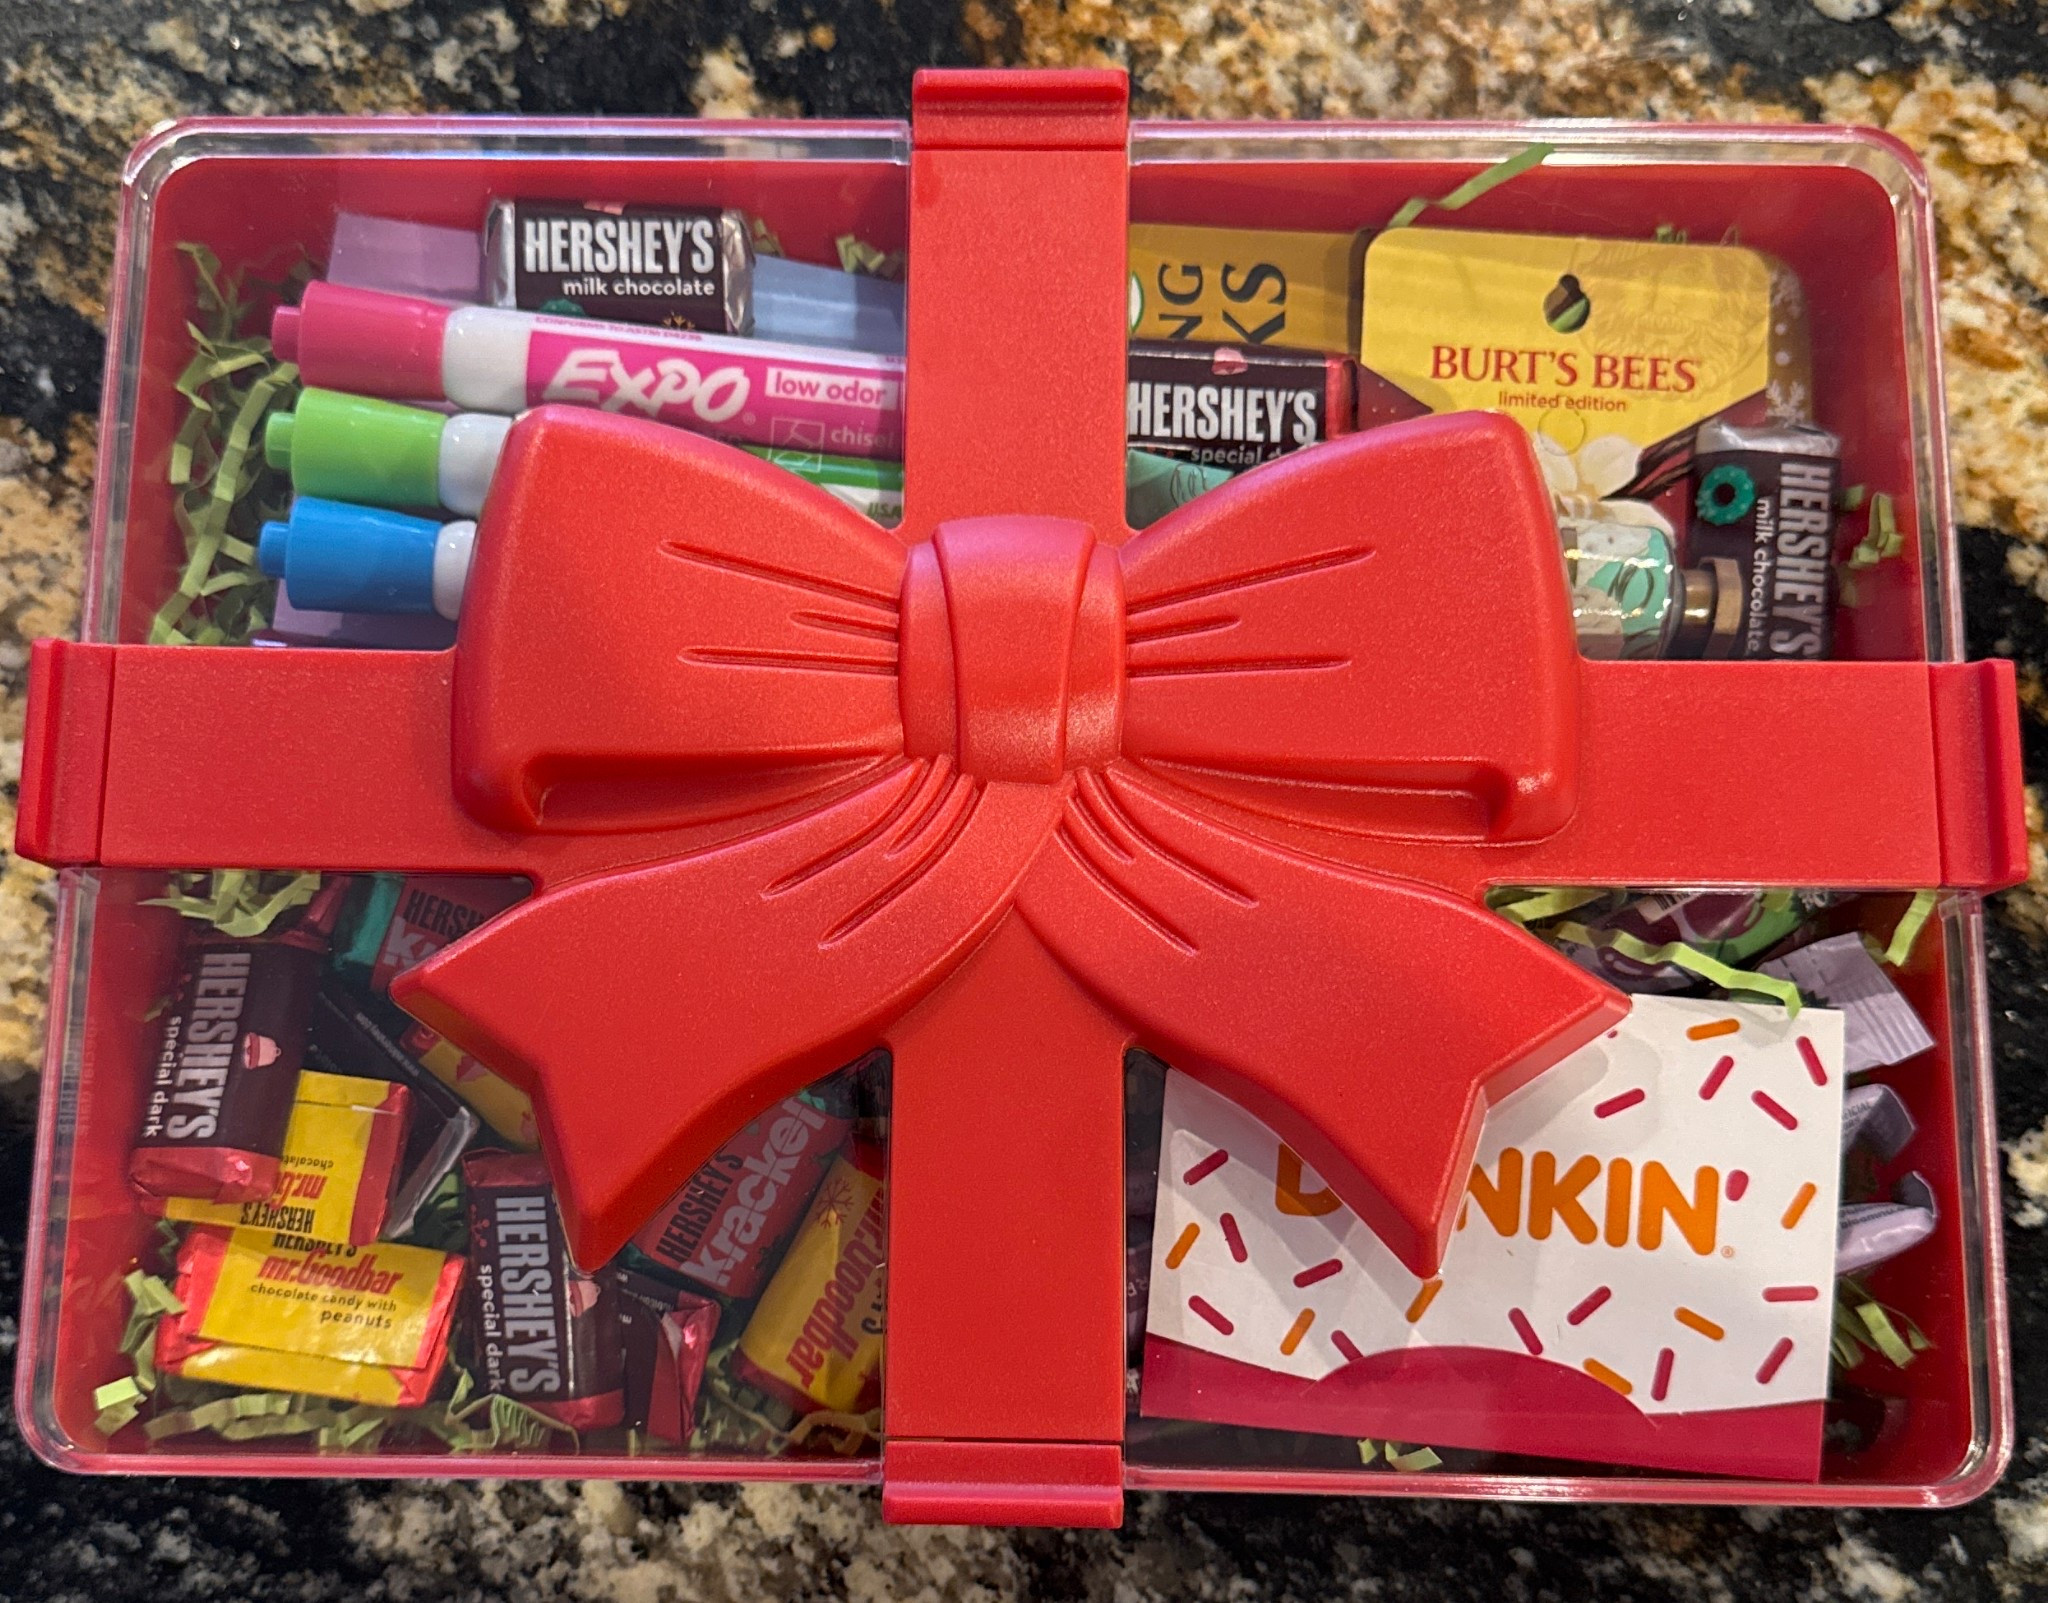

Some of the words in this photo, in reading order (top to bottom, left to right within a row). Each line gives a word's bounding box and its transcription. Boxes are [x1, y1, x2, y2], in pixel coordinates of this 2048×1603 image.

[525, 219, 715, 274] HERSHEY'S
[563, 275, 608, 296] milk
[613, 276, 715, 296] chocolate
[541, 348, 750, 423] EXPO
[775, 371, 820, 398] low
[826, 380, 887, 405] odor
[1430, 345, 1578, 387] BURT'S
[1592, 353, 1700, 393] BEES
[1128, 382, 1318, 445] HERSHEY'S
[1499, 391, 1559, 410] limited
[1565, 393, 1627, 412] edition
[1190, 445, 1262, 469] special
[1755, 498, 1775, 544] milk
[1769, 463, 1831, 655] HERSHEY'S
[1747, 549, 1771, 652] chocolate
[153, 1015, 182, 1086] special
[166, 953, 251, 1139] HERSHEY'S
[143, 1090, 170, 1138] dark
[258, 1248, 404, 1296] mr.Goodbar
[496, 1196, 561, 1393] HERSHEY'S
[250, 1283, 318, 1302] chocolate
[322, 1293, 362, 1310] candy
[367, 1299, 397, 1312] with
[320, 1310, 392, 1329] peanuts
[476, 1264, 501, 1338] special
[485, 1343, 506, 1391] dark
